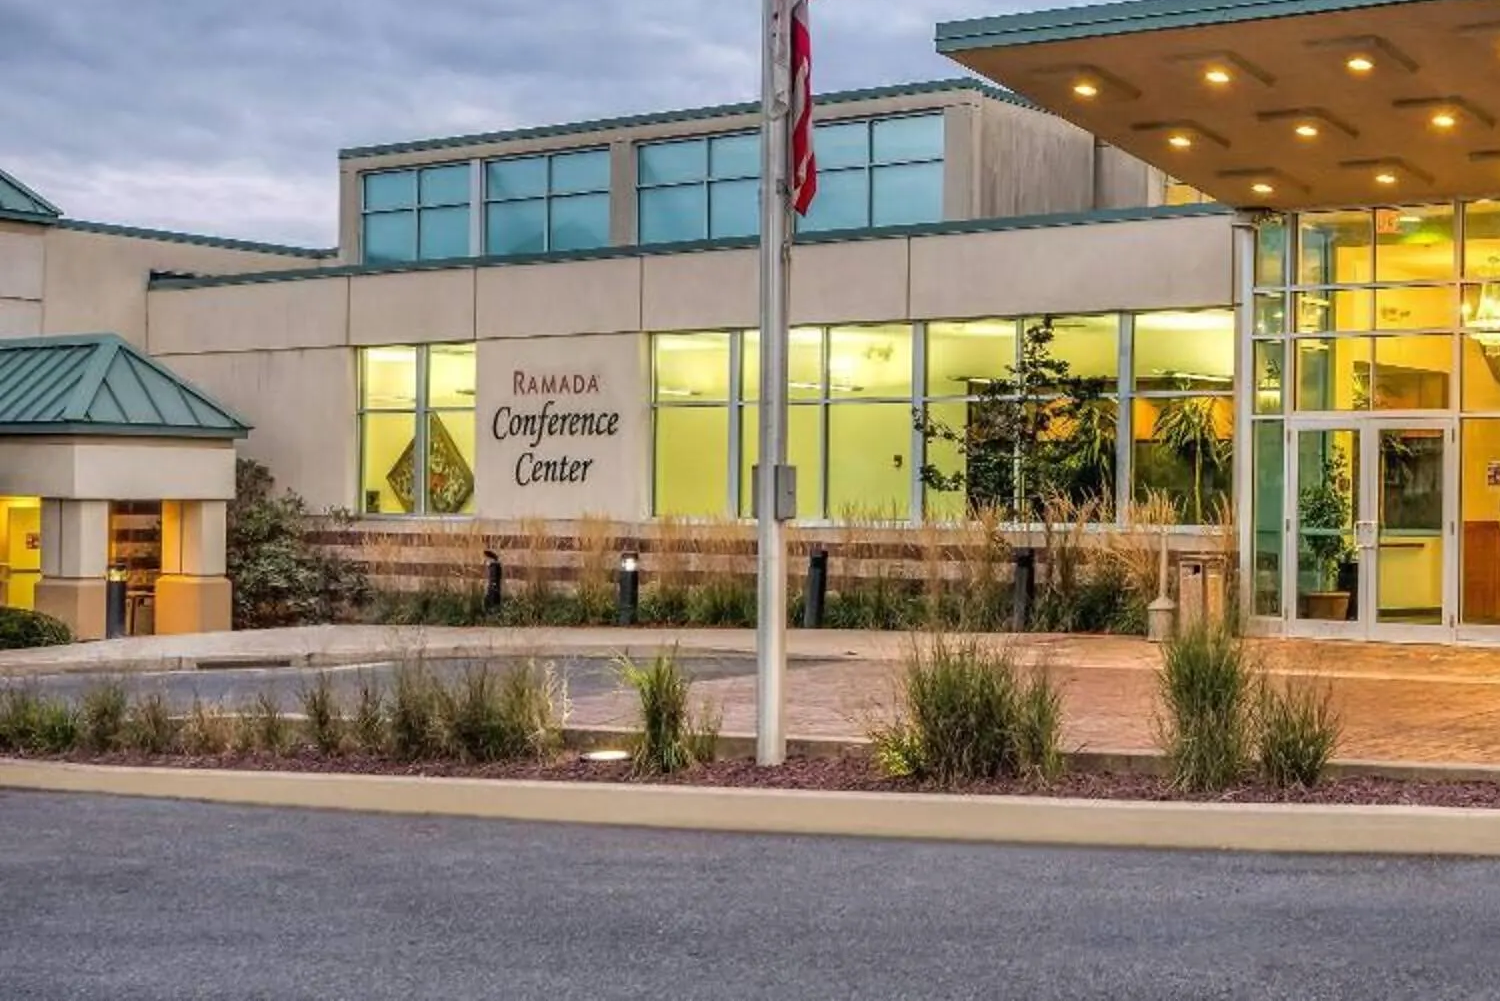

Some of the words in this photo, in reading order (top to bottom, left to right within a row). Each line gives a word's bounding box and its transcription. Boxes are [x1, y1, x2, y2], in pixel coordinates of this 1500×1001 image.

[513, 370, 599, 395] RAMADA
[492, 400, 619, 447] Conference
[515, 452, 593, 486] Center
